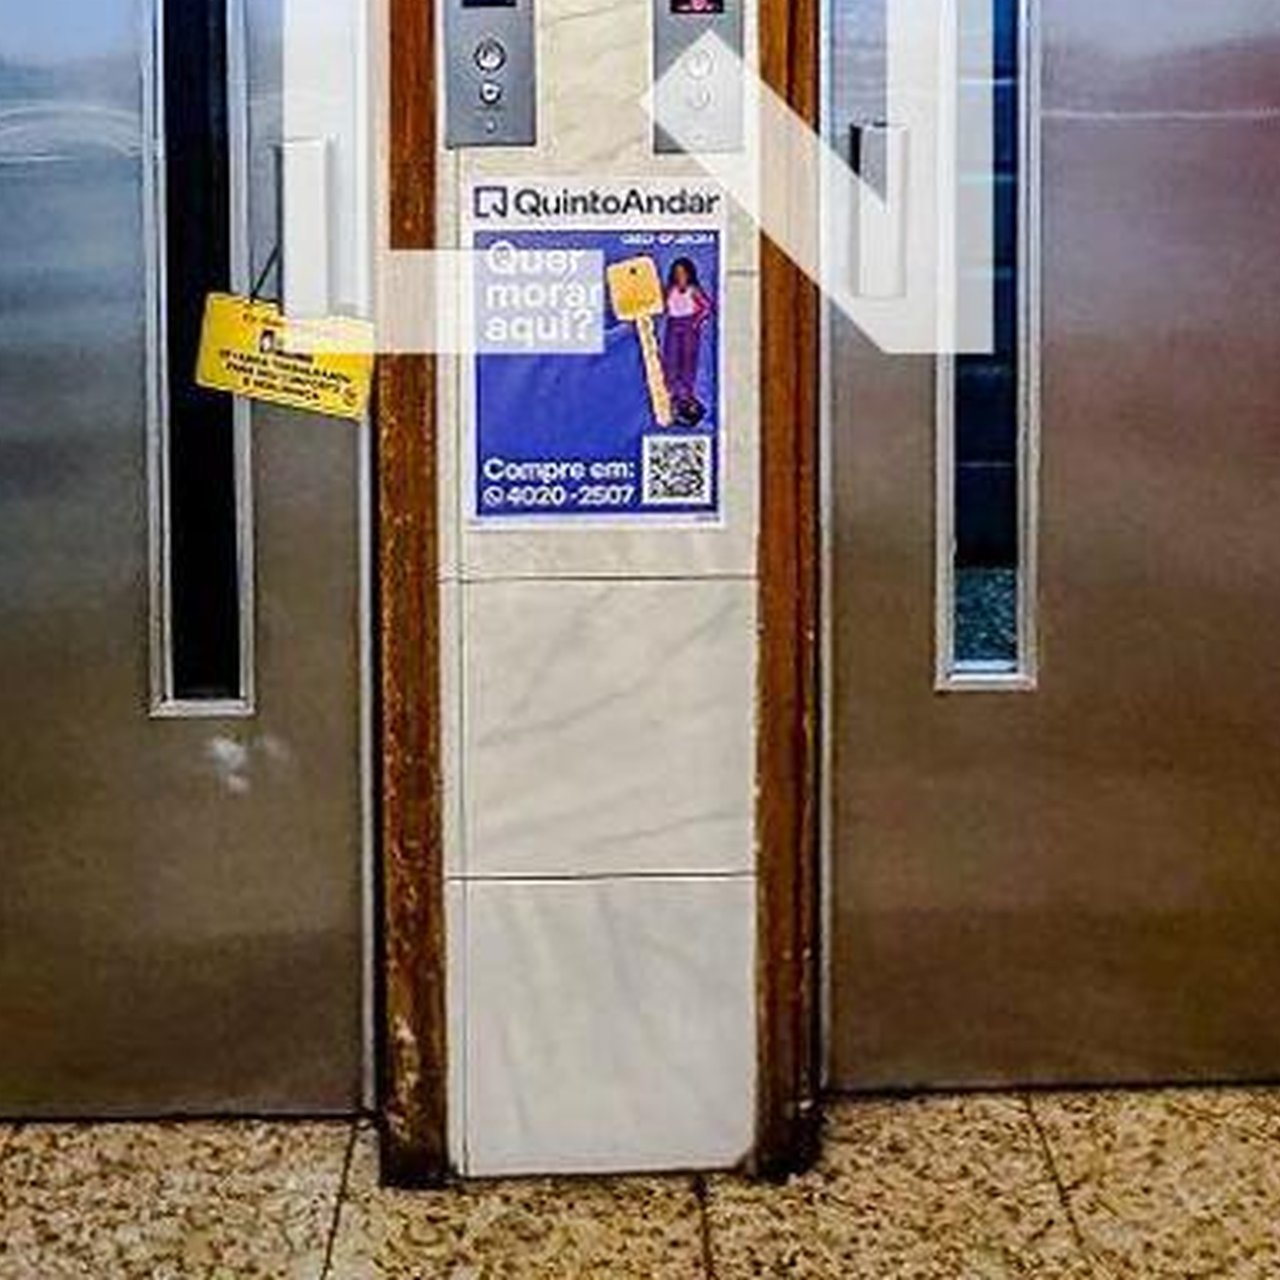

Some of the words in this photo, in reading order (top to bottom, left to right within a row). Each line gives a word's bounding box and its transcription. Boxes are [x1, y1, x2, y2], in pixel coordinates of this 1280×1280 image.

[513, 188, 720, 217] QuintoAndar
[486, 240, 587, 274] Quer
[485, 279, 600, 308] morar
[484, 308, 594, 348] aqui?
[483, 457, 586, 483] Compre
[589, 463, 635, 479] em:
